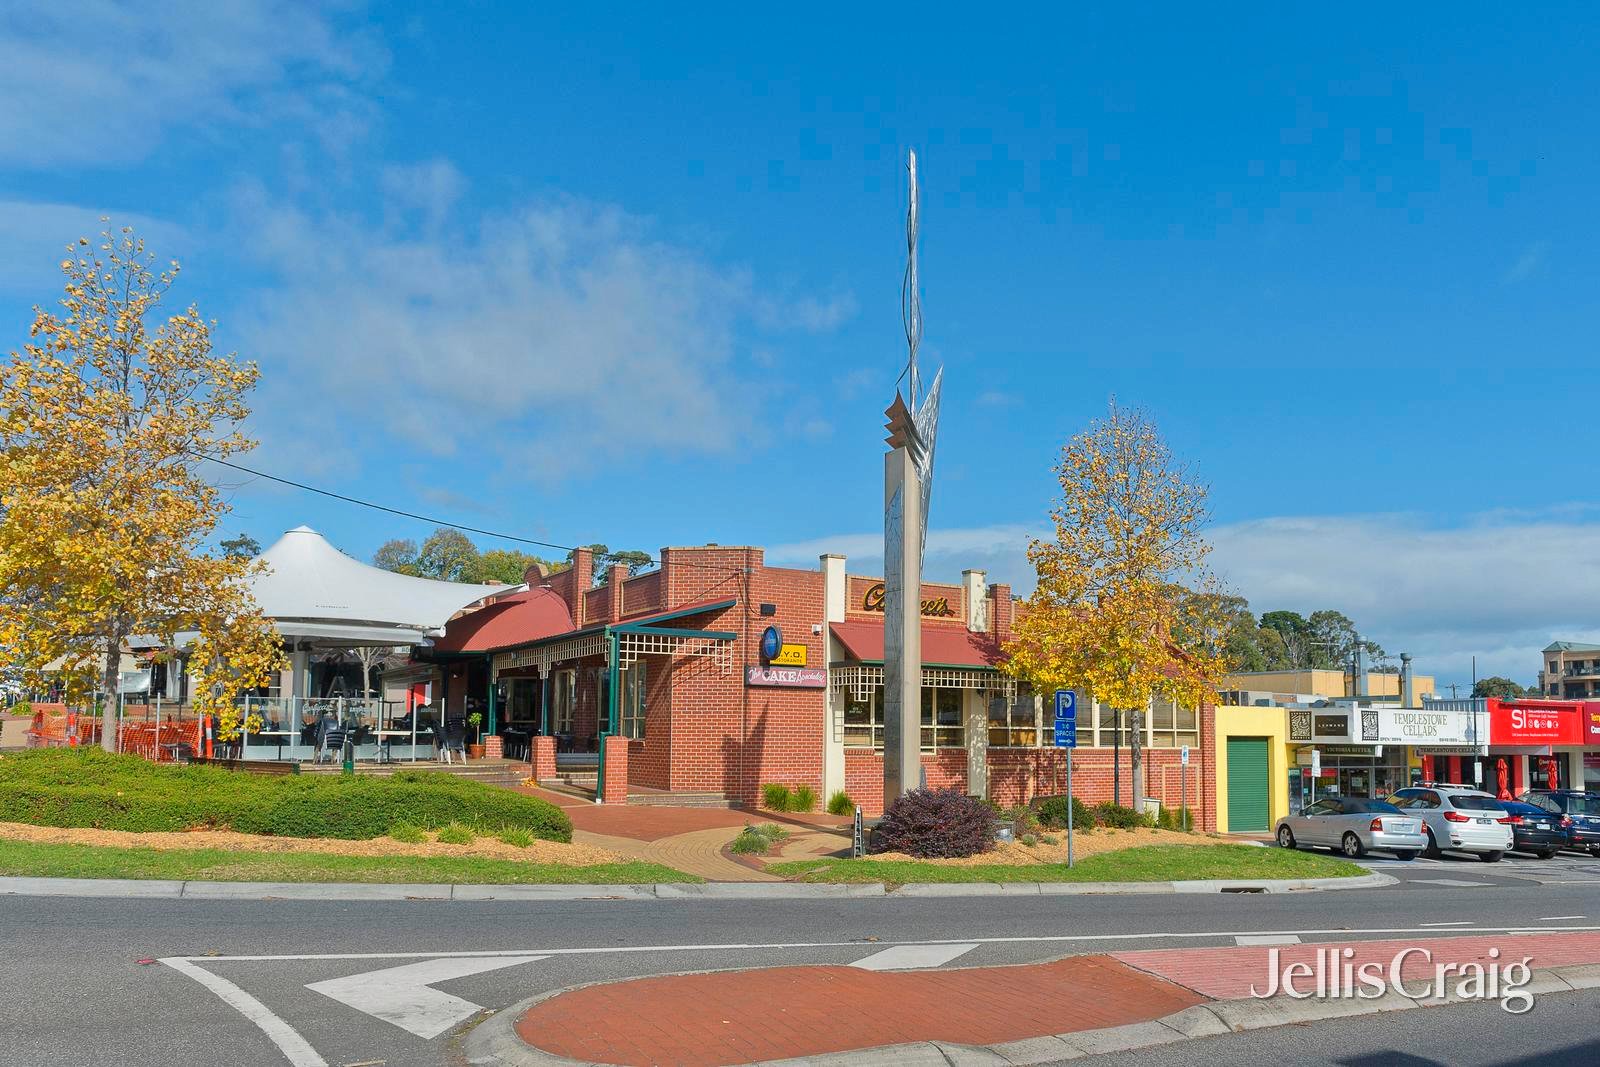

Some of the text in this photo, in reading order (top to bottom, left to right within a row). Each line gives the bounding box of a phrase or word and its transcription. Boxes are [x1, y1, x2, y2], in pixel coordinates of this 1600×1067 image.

[748, 668, 762, 682] The
[762, 670, 797, 682] CAKE
[1059, 693, 1072, 716] P
[1393, 713, 1448, 725] TEMPLESTOWE
[1511, 709, 1526, 729] SI
[1402, 724, 1438, 736] CELLARS
